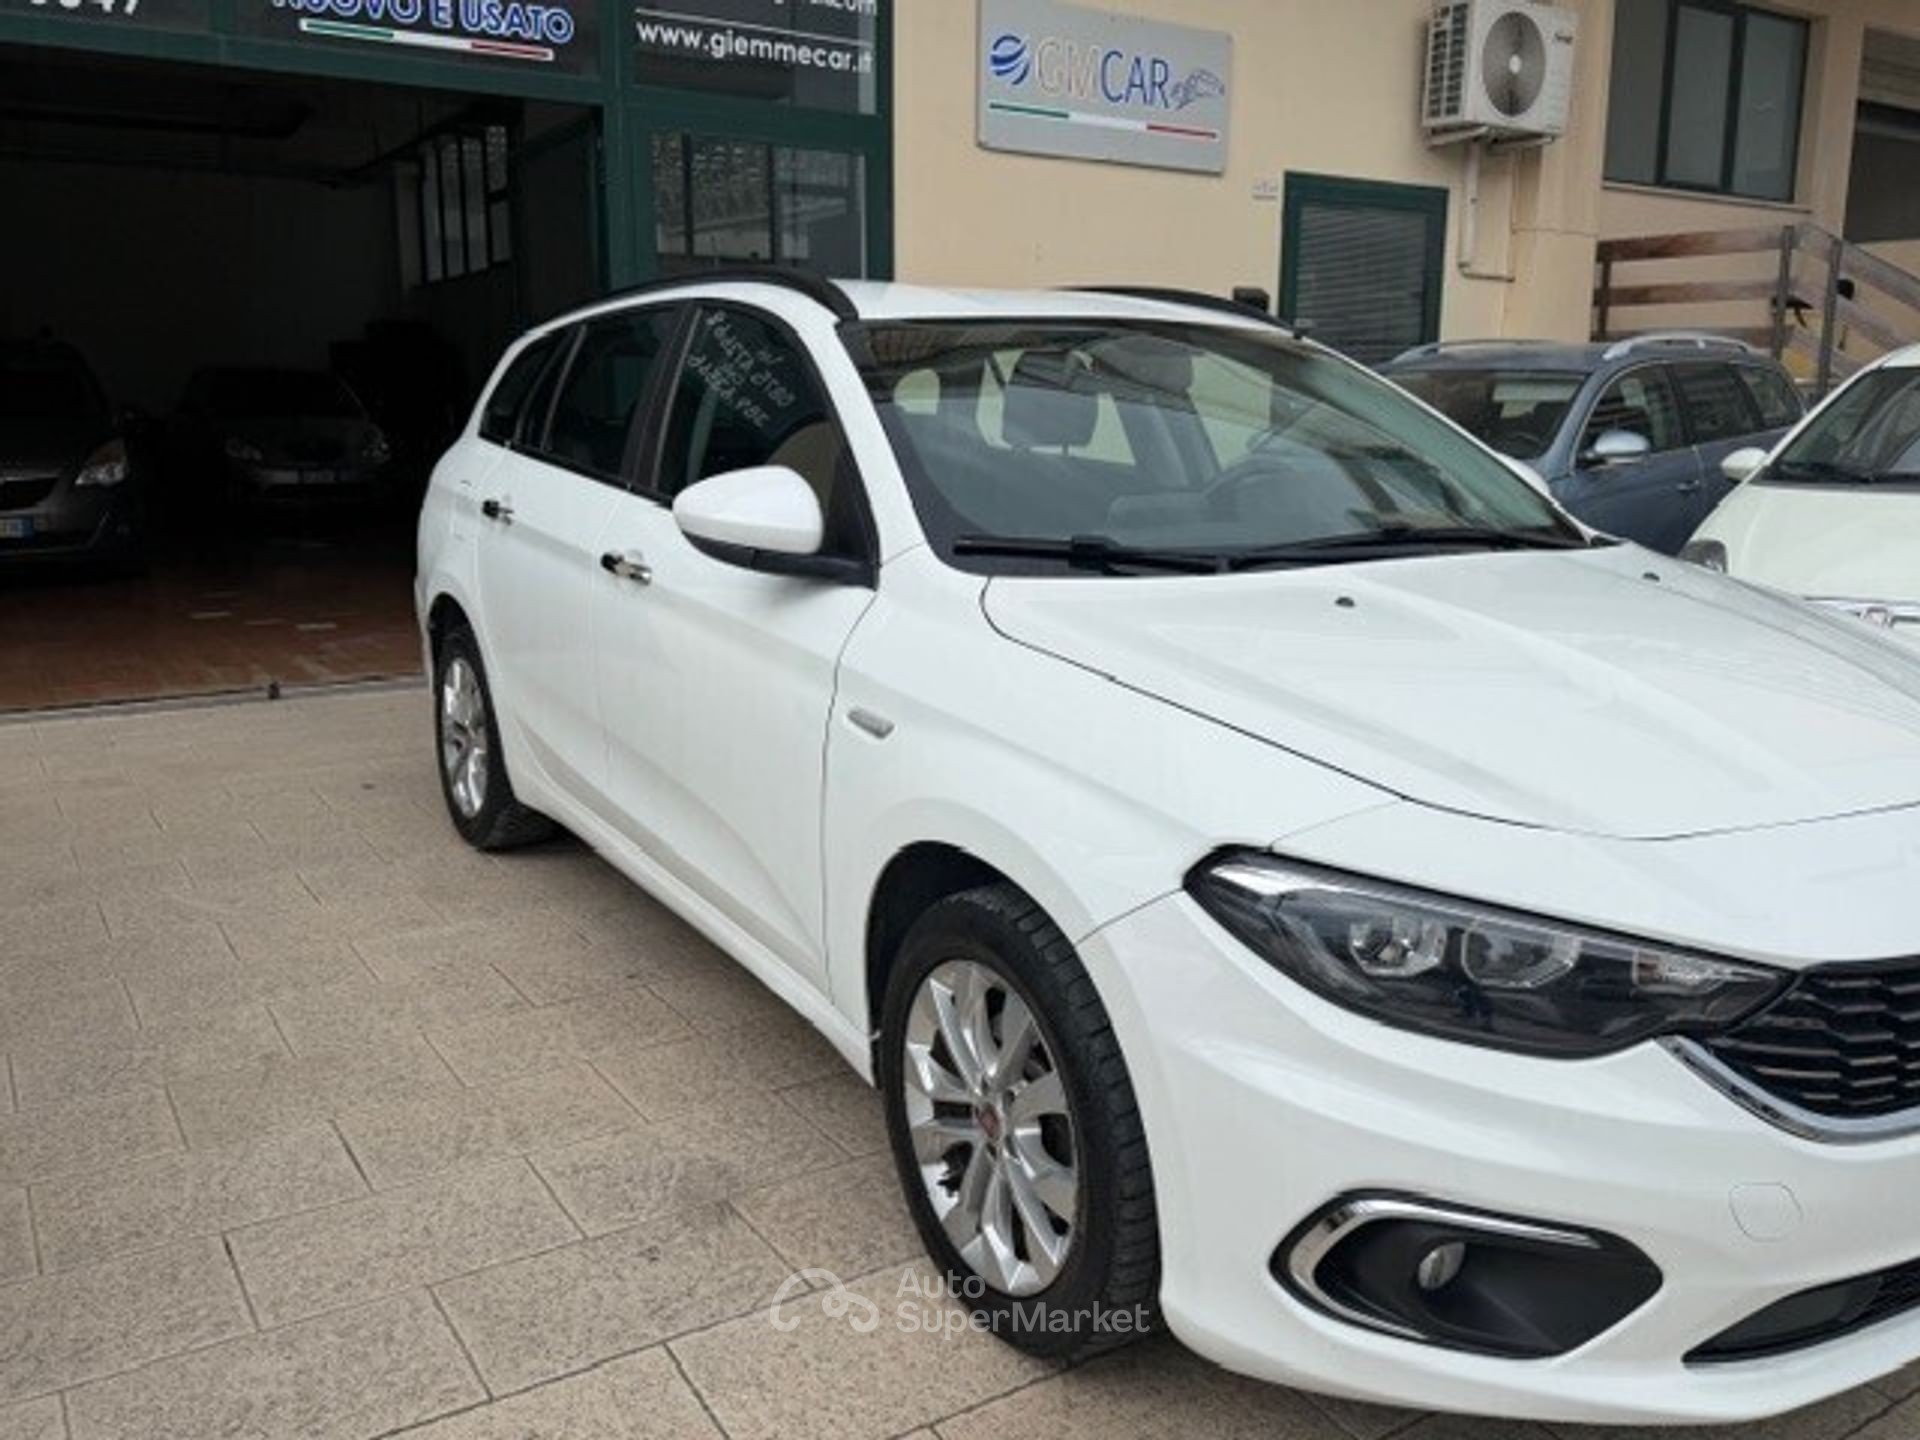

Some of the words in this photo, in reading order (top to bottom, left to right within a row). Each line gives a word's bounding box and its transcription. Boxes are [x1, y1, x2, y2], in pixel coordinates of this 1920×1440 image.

[430, 0, 453, 28] E
[460, 1, 574, 43] USATO
[636, 21, 873, 73] www.giemmecar.it
[1035, 37, 1170, 108] GMCAR
